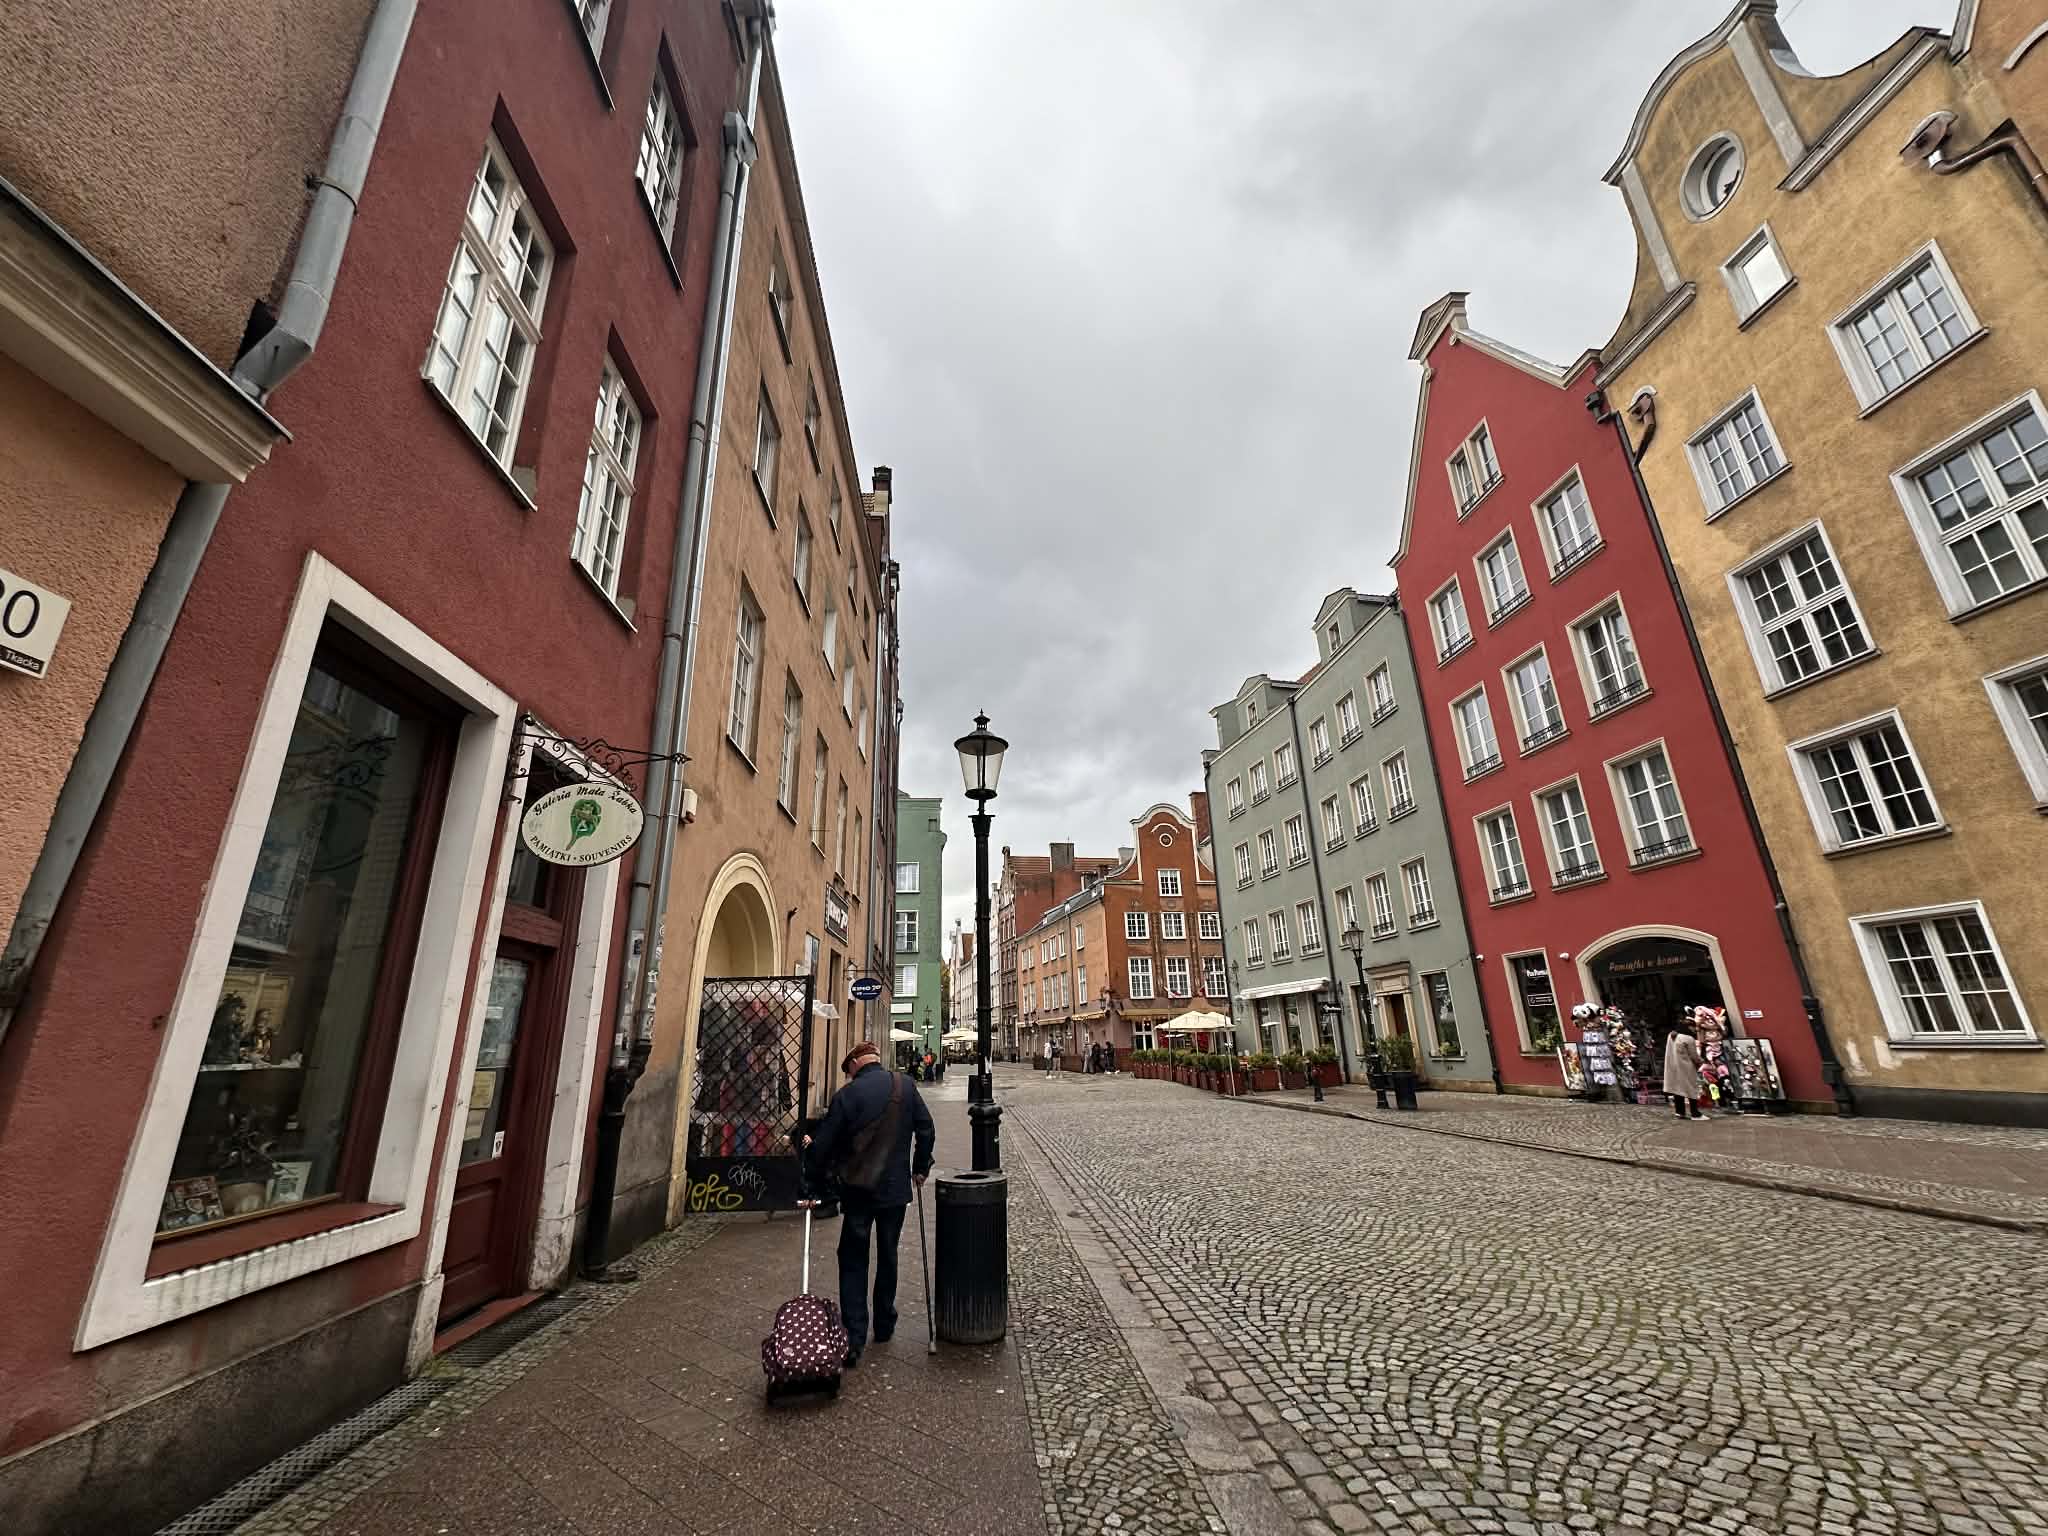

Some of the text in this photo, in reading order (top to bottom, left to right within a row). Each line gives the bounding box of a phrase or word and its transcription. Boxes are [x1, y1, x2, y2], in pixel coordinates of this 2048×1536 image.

[0, 577, 41, 639] 0
[5, 649, 41, 671] Tkacka
[533, 786, 638, 816] Galeria Mała Żabka
[530, 834, 633, 862] PAMIĄTKI SOUVENIRS
